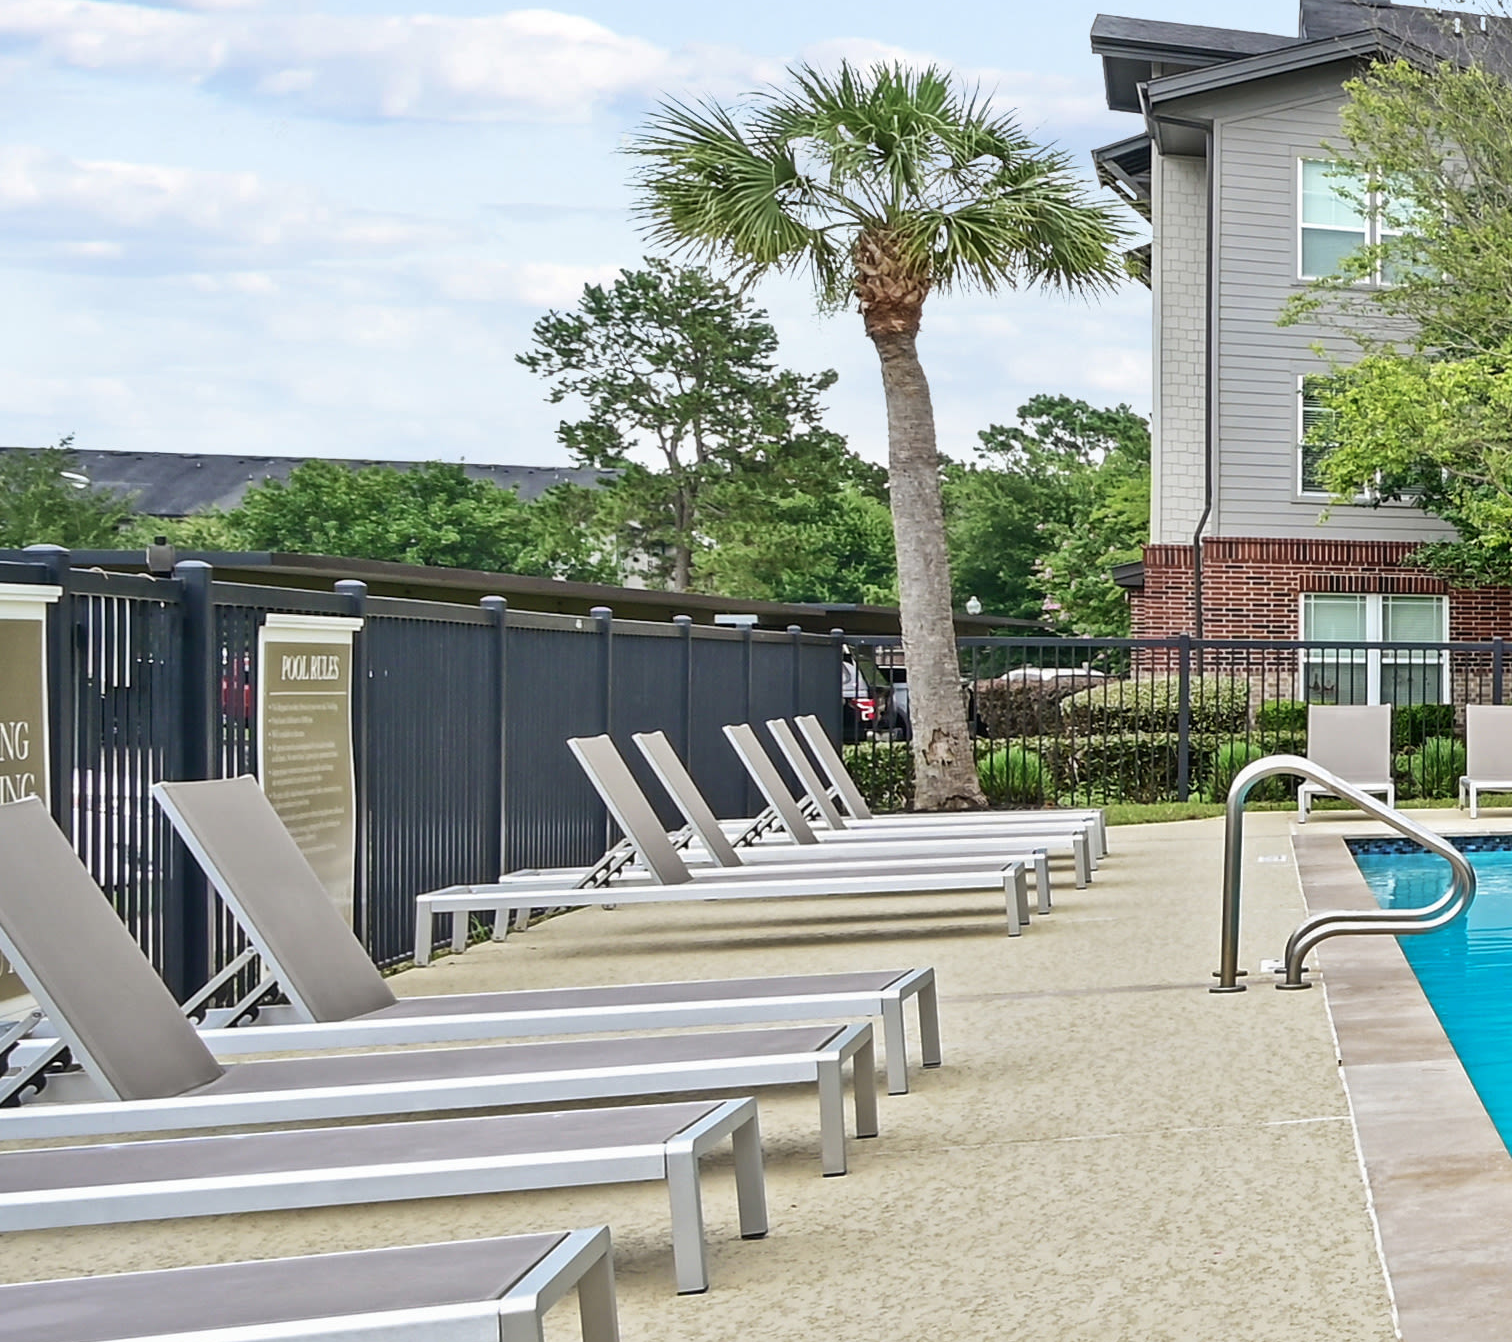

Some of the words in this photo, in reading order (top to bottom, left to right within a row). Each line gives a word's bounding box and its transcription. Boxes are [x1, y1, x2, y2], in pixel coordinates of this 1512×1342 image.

[281, 655, 309, 680] POOL
[310, 655, 340, 680] RULES
[0, 721, 30, 762] NG
